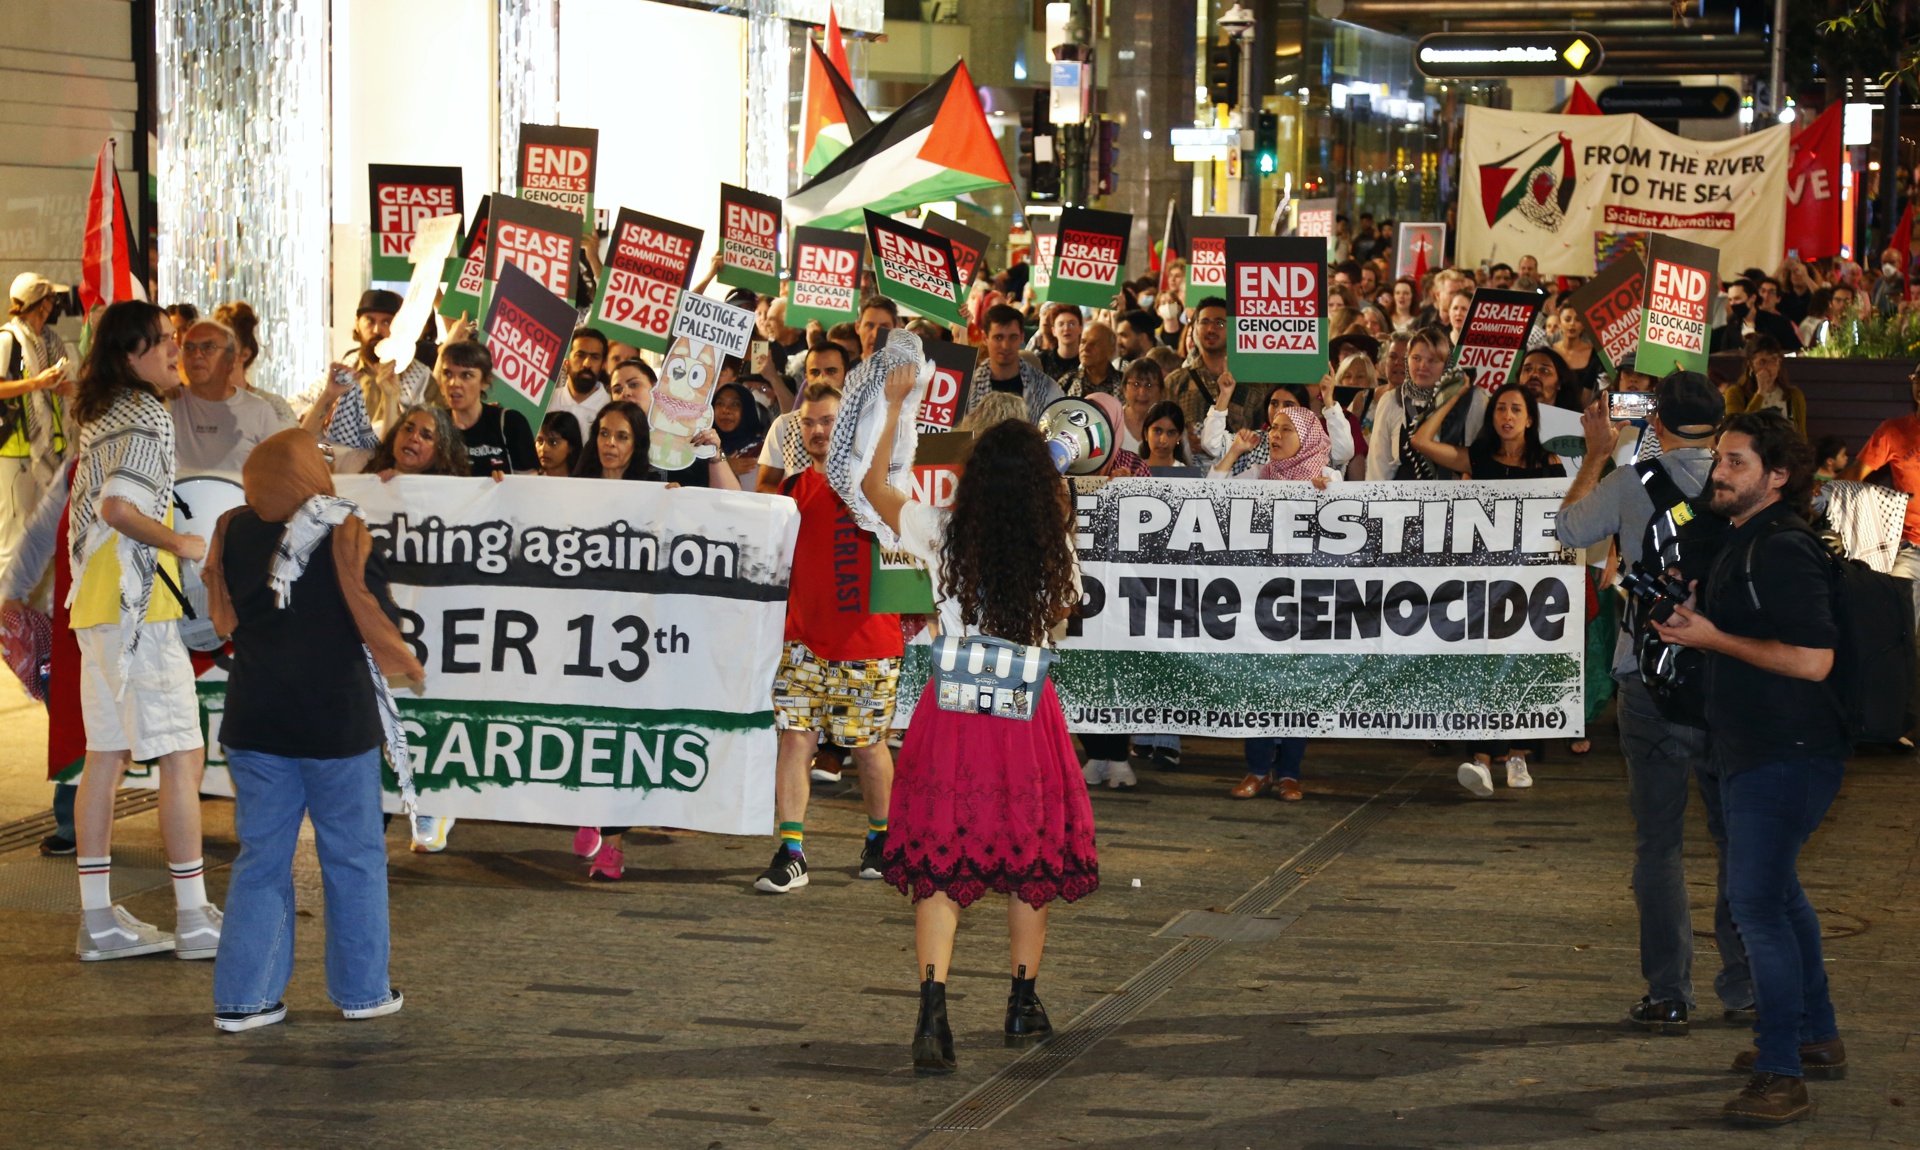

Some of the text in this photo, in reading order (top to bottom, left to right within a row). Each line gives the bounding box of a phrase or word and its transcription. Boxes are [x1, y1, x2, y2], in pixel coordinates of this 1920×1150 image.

[528, 147, 588, 176] END
[1584, 144, 1651, 168] FROM
[1659, 150, 1699, 175] THE
[1704, 155, 1765, 176] RIVER
[527, 174, 586, 191] ISRAEL'S
[1611, 174, 1733, 204] TO THE SEA
[379, 186, 453, 206] CEASE
[524, 190, 585, 204] GENOCIDE
[728, 204, 775, 236] END
[1300, 210, 1332, 222] CEASE
[1606, 208, 1731, 230] Socialist Alternative
[621, 223, 692, 259] ISRAEL:
[727, 228, 774, 250] ISRAEL'S
[1064, 232, 1121, 249] BOYCOTT
[1300, 221, 1332, 237] FIRE
[498, 225, 570, 261] CEASE
[725, 241, 774, 261] GENOCIDE
[878, 229, 944, 267] END
[1062, 243, 1118, 263] ISRAEL
[1193, 241, 1225, 250] BOYC
[618, 244, 684, 270] COMMITTING
[725, 252, 774, 273] IN GAZA
[800, 246, 854, 274] END
[882, 248, 948, 279] ISRAEL'S
[615, 256, 683, 285] GENOCIDE
[799, 270, 852, 287] ISRAEL'S
[884, 260, 951, 289] BLOCKADE
[1059, 260, 1116, 281] NOW
[1240, 266, 1315, 298] END
[1654, 262, 1706, 302] END
[609, 272, 677, 307] SINCE
[797, 283, 851, 298] BLOCKADE
[886, 269, 954, 300] OF GAZA
[796, 293, 850, 309] OF GAZA
[1240, 300, 1315, 315] ISRAEL'S
[1475, 302, 1531, 322] ISRAEL:
[1590, 278, 1643, 331] STOP
[1651, 294, 1704, 320] ISRAEL'S
[499, 302, 560, 351] BOYCOTT
[604, 295, 670, 333] 1948
[737, 316, 748, 331] 4
[1238, 319, 1315, 332] GENOCIDE
[1649, 312, 1703, 336] BLOCKADE
[678, 316, 743, 352] PALESTINE
[1466, 333, 1519, 347] GENOCIDE
[1470, 322, 1523, 334] COMMITTING
[1648, 326, 1701, 351] OF GAZA
[492, 317, 550, 374] ISRAEL
[1239, 334, 1316, 350] IN GAZA
[488, 340, 546, 398] NOW
[1458, 347, 1514, 369] SINCE
[1118, 496, 1563, 556] PALESTINE
[523, 522, 656, 577] again
[672, 540, 734, 579] on
[881, 552, 910, 565] WAR
[563, 614, 690, 683] 13th
[1162, 708, 1201, 726] FOR
[384, 717, 708, 788] GARDENS
